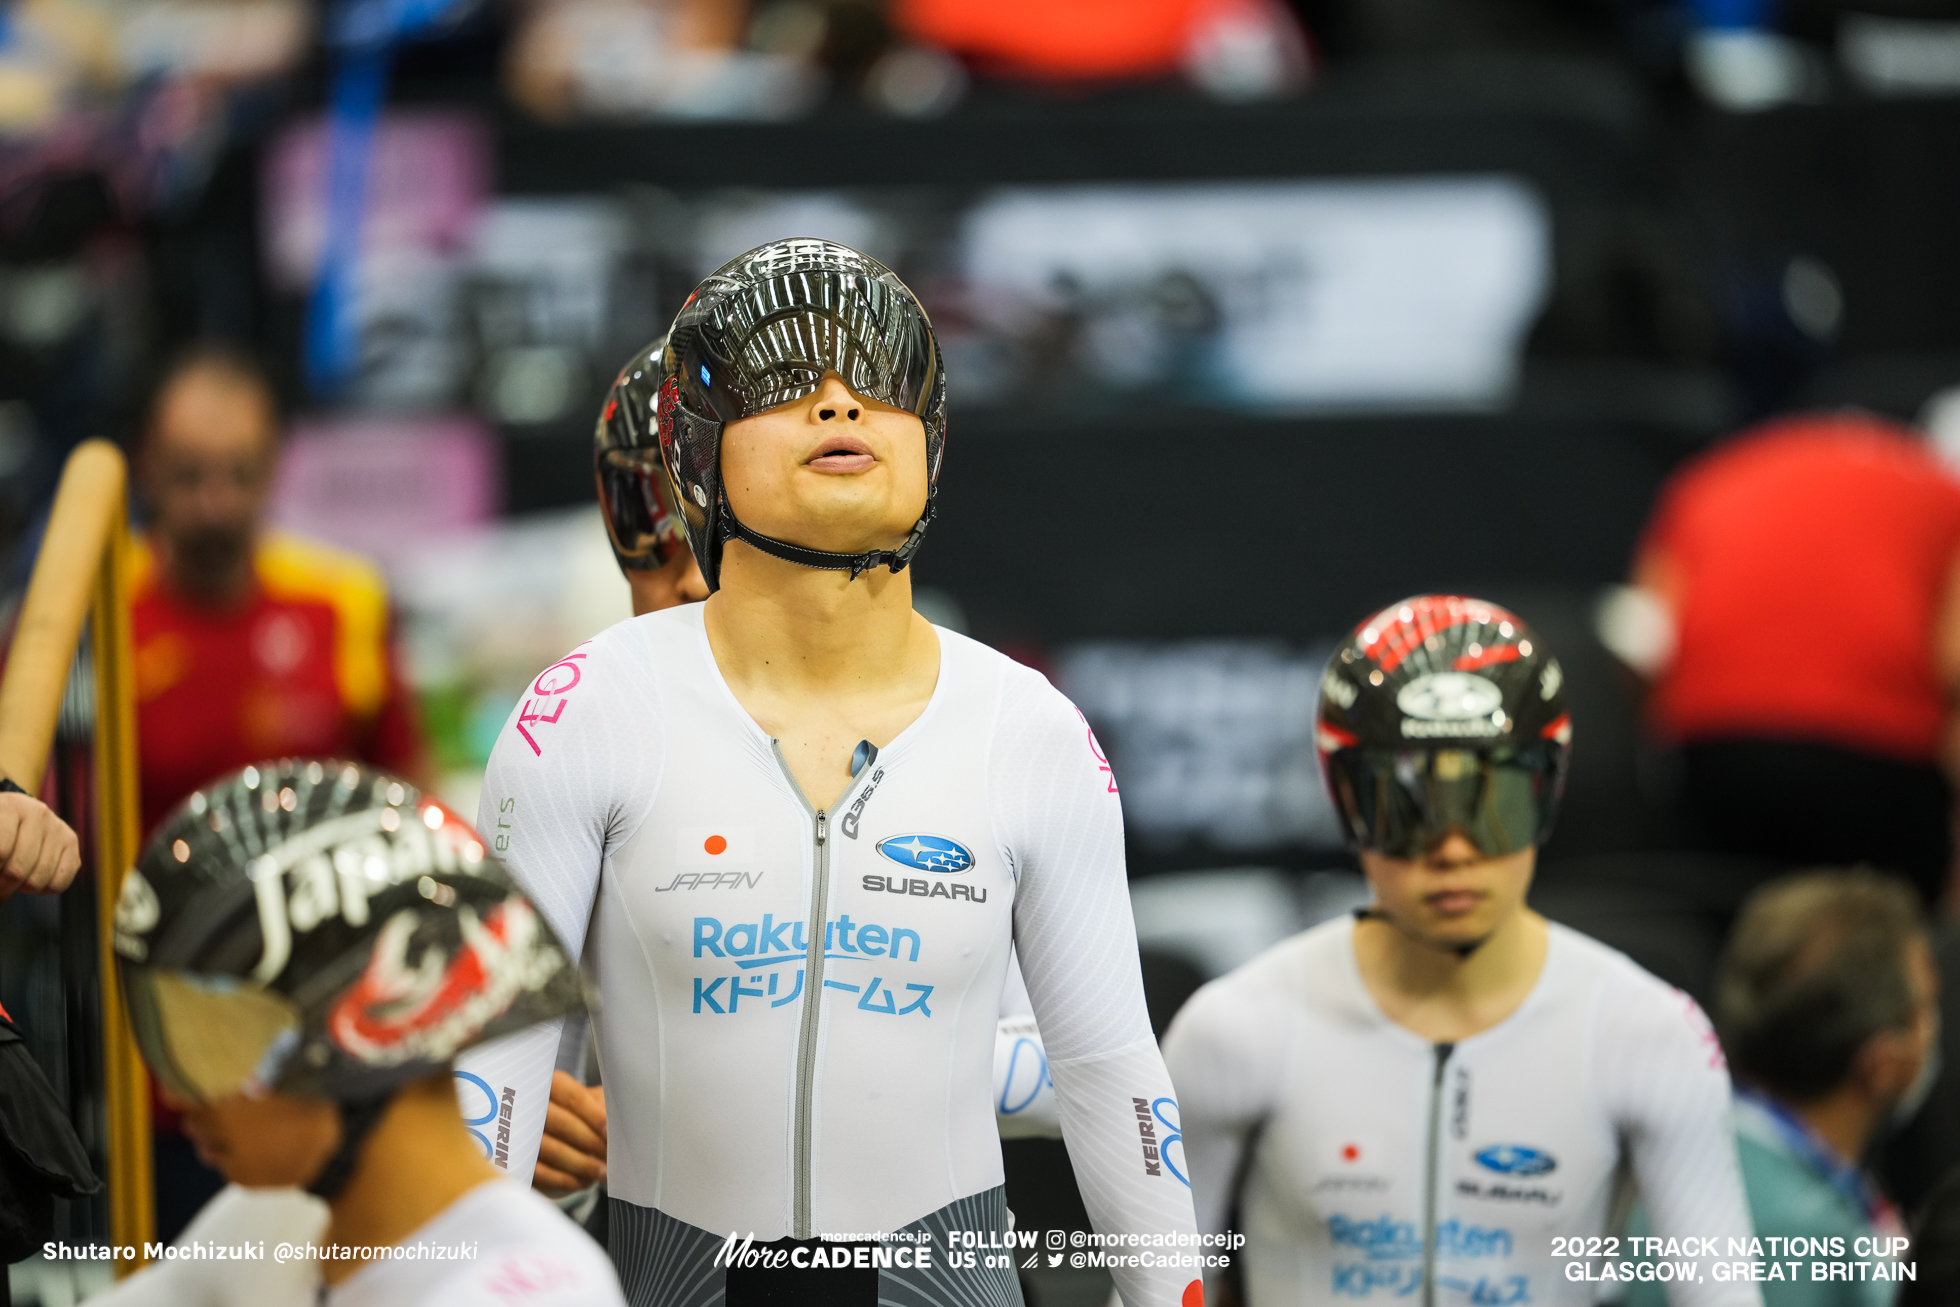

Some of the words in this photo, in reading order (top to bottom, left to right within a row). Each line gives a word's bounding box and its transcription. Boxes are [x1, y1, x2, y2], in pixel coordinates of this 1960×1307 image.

[655, 871, 764, 892] JAPAN
[862, 875, 987, 904] SUBARU
[693, 913, 921, 963] Rakuten
[692, 969, 935, 1018] Kドリームス
[495, 1086, 516, 1170] KEIRIN
[1132, 1097, 1161, 1177] KEIRIN
